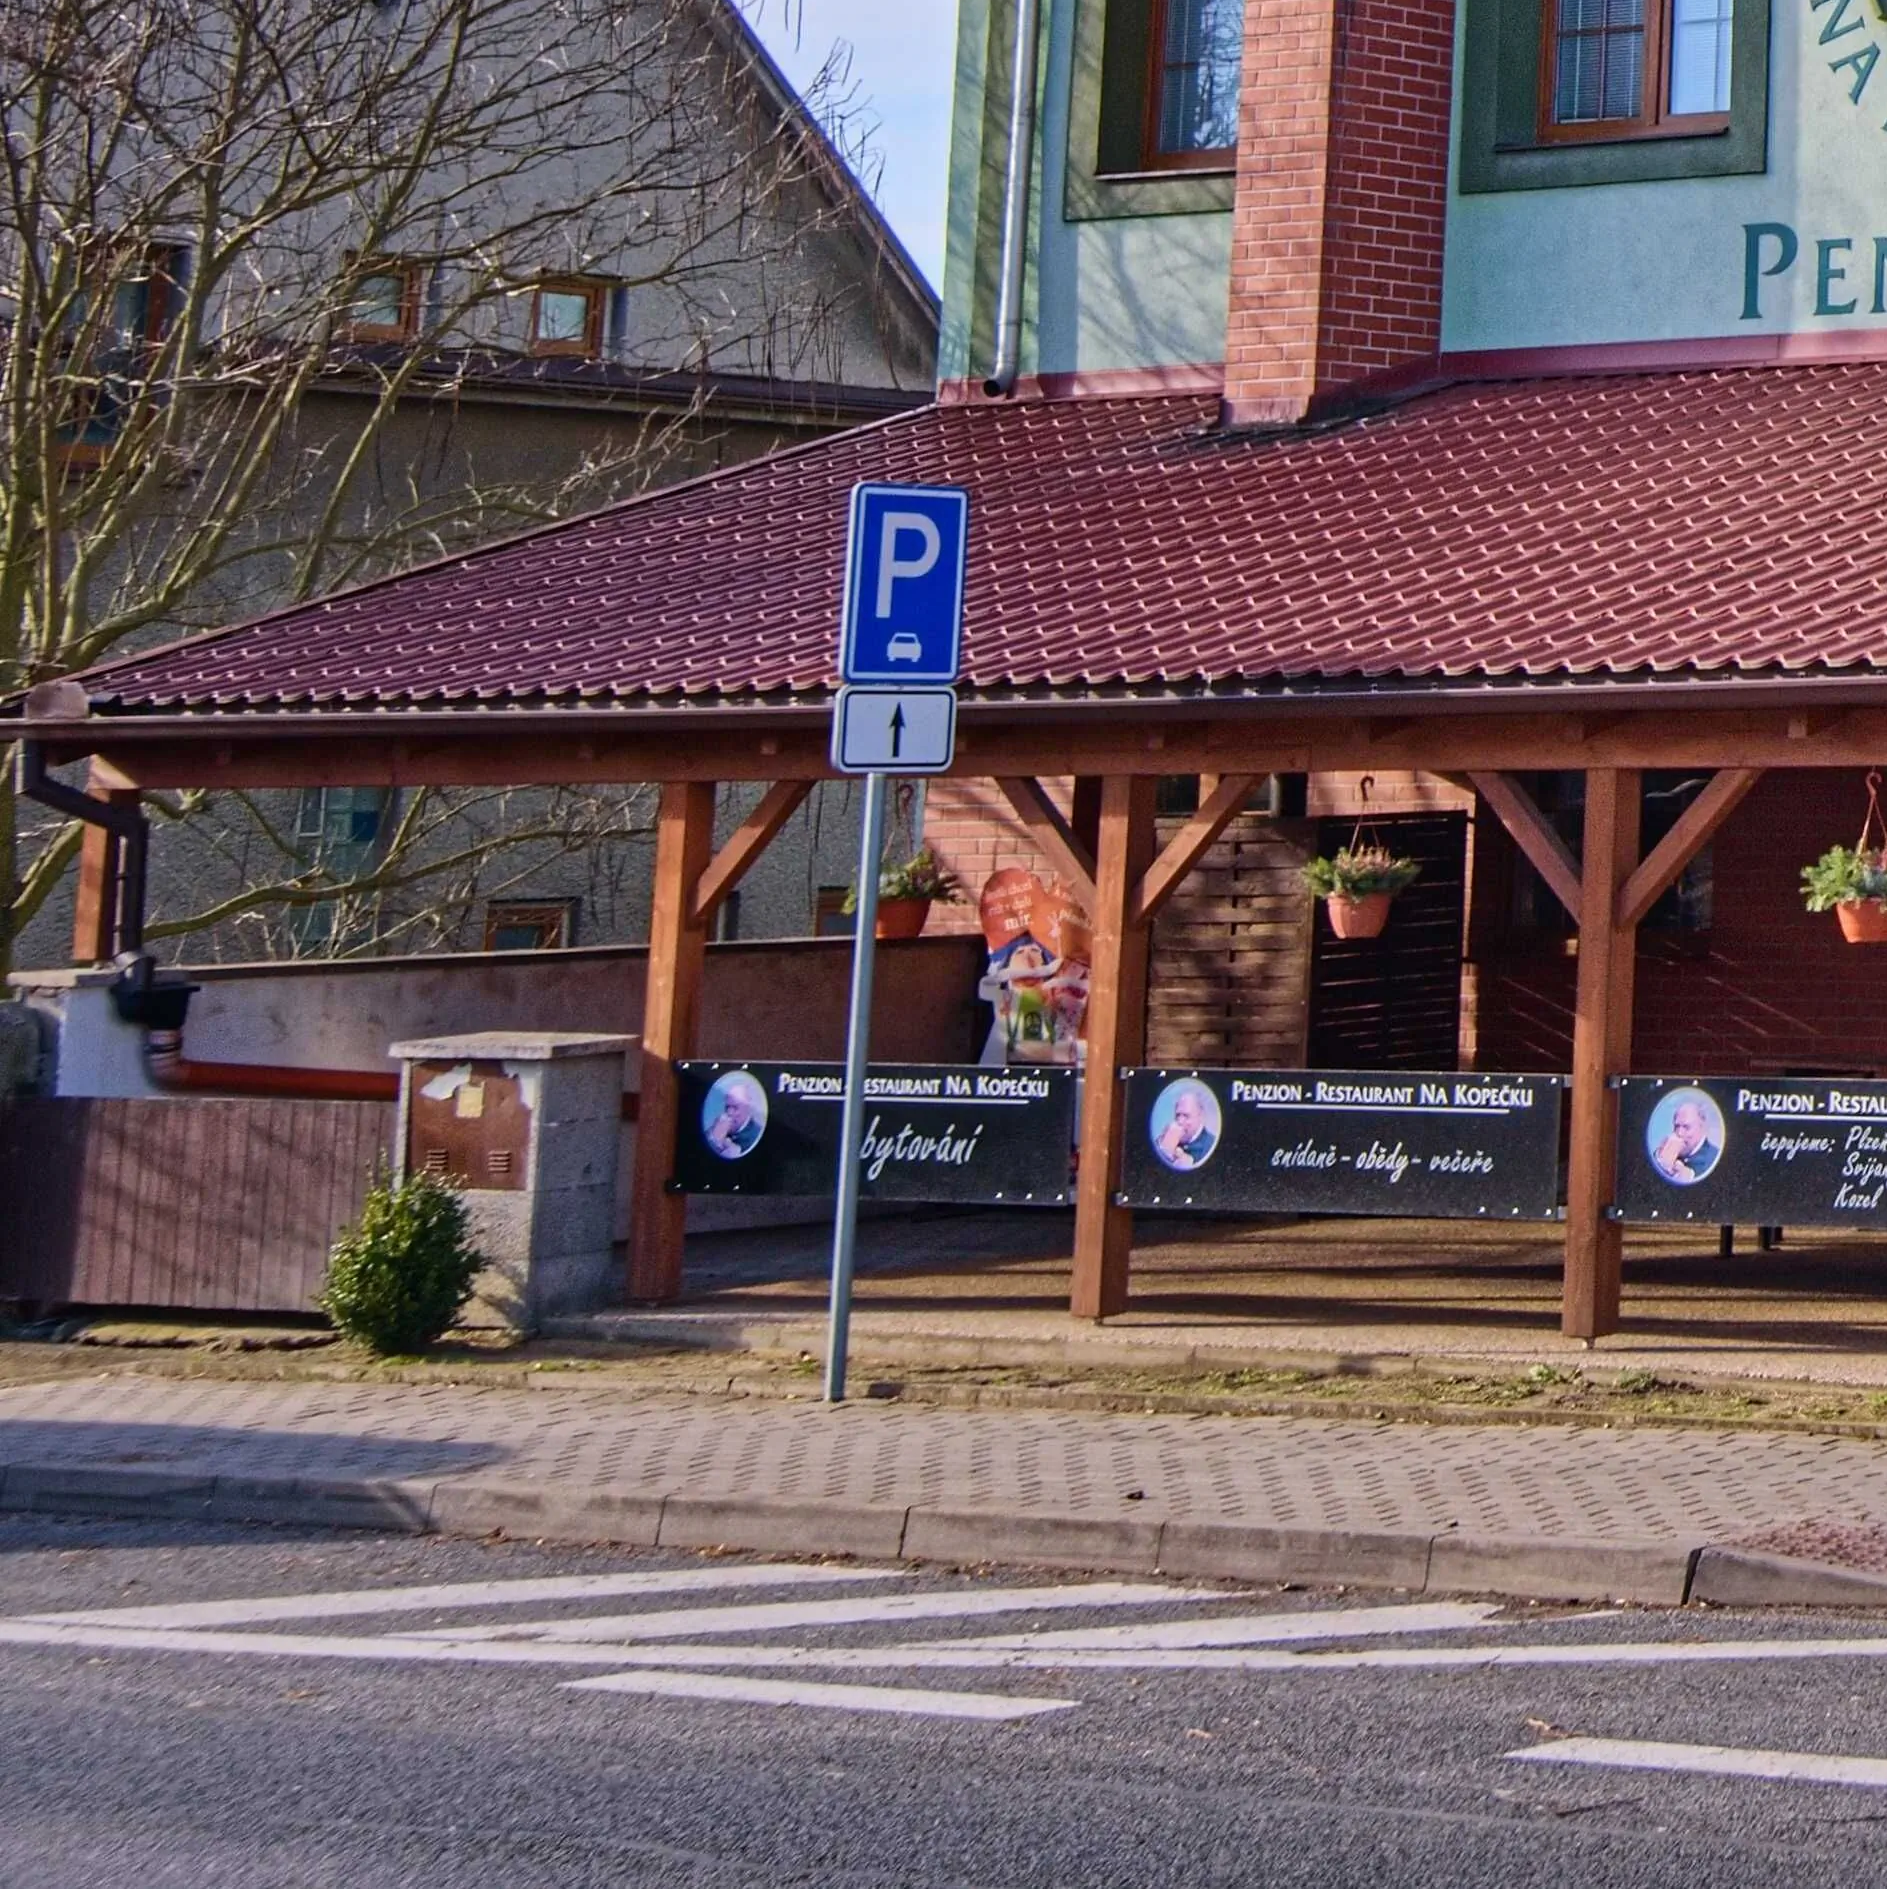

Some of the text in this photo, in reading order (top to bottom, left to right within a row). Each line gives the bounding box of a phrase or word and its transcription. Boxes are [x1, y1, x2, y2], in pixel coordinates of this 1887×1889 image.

[875, 511, 941, 618] P
[778, 1073, 1049, 1098] PENZION ESTAURANT NA KOPEČKU
[1231, 1080, 1301, 1101] PENZION
[1316, 1081, 1413, 1104] RESTAURANT
[1419, 1084, 1448, 1104] NA
[1454, 1084, 1533, 1108] KOPEČKU
[1737, 1089, 1814, 1111] PENZION
[860, 1115, 983, 1181] bytování
[1271, 1138, 1337, 1169] snídaně
[1355, 1140, 1409, 1184] obědy
[1428, 1149, 1494, 1174] večeře
[1833, 1184, 1884, 1209] Kozel
